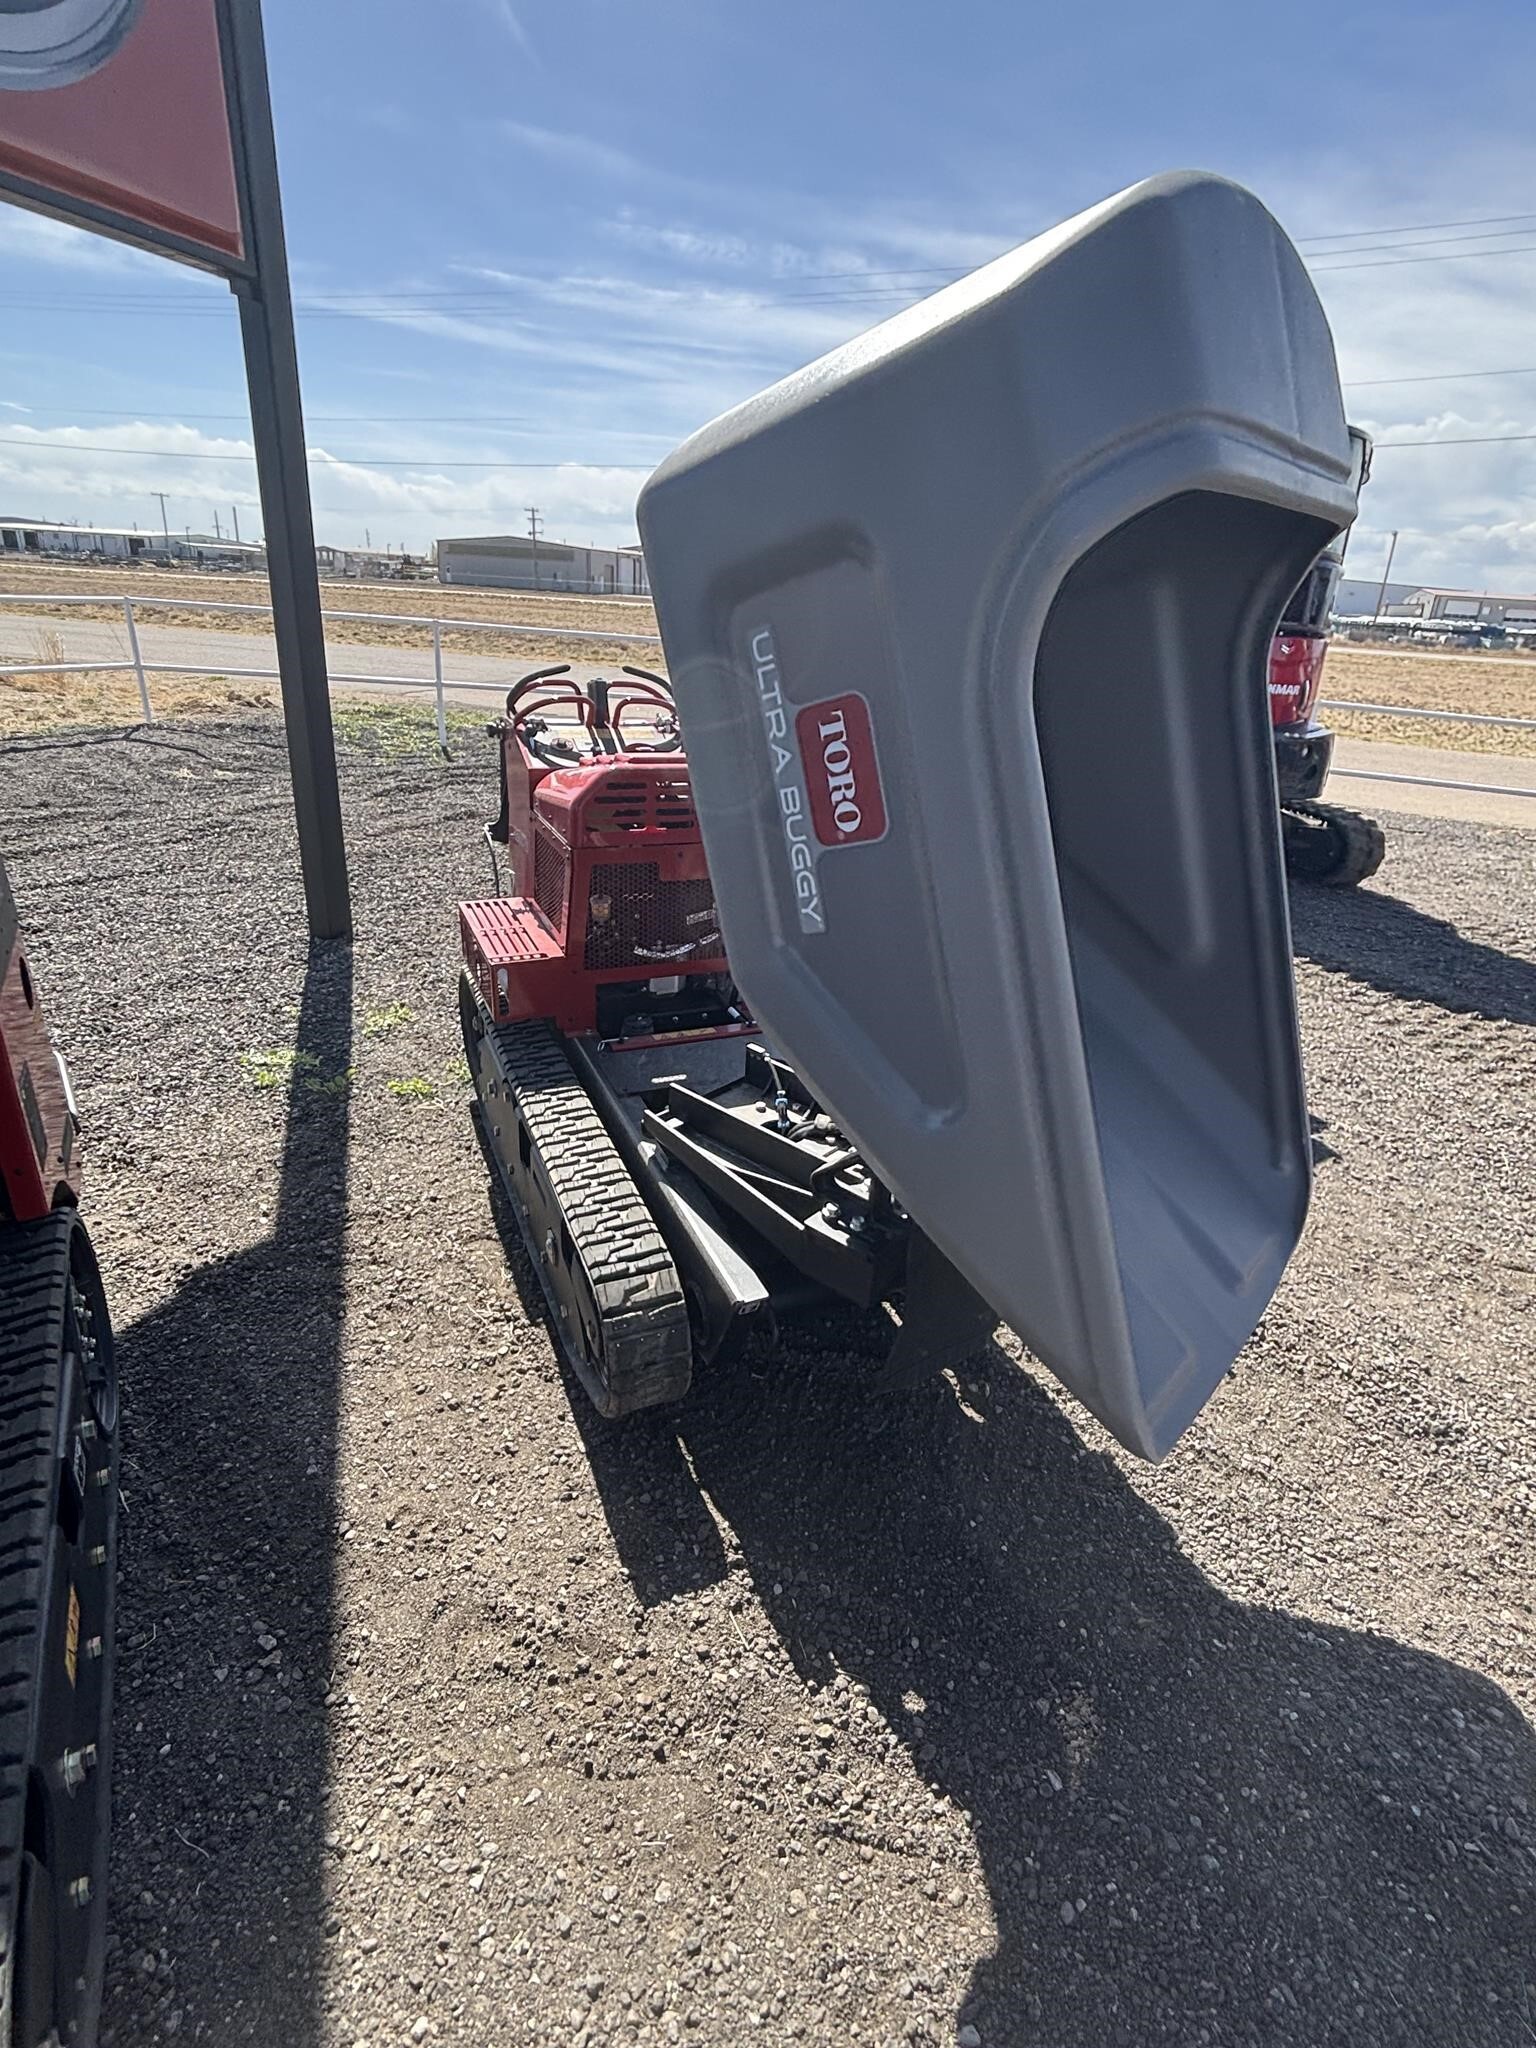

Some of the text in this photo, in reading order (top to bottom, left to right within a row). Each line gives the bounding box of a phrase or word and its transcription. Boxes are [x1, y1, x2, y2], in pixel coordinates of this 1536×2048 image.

[1267, 683, 1301, 696] NMAR
[752, 631, 821, 922] ULTRA BUGGY
[818, 710, 861, 832] TORO
